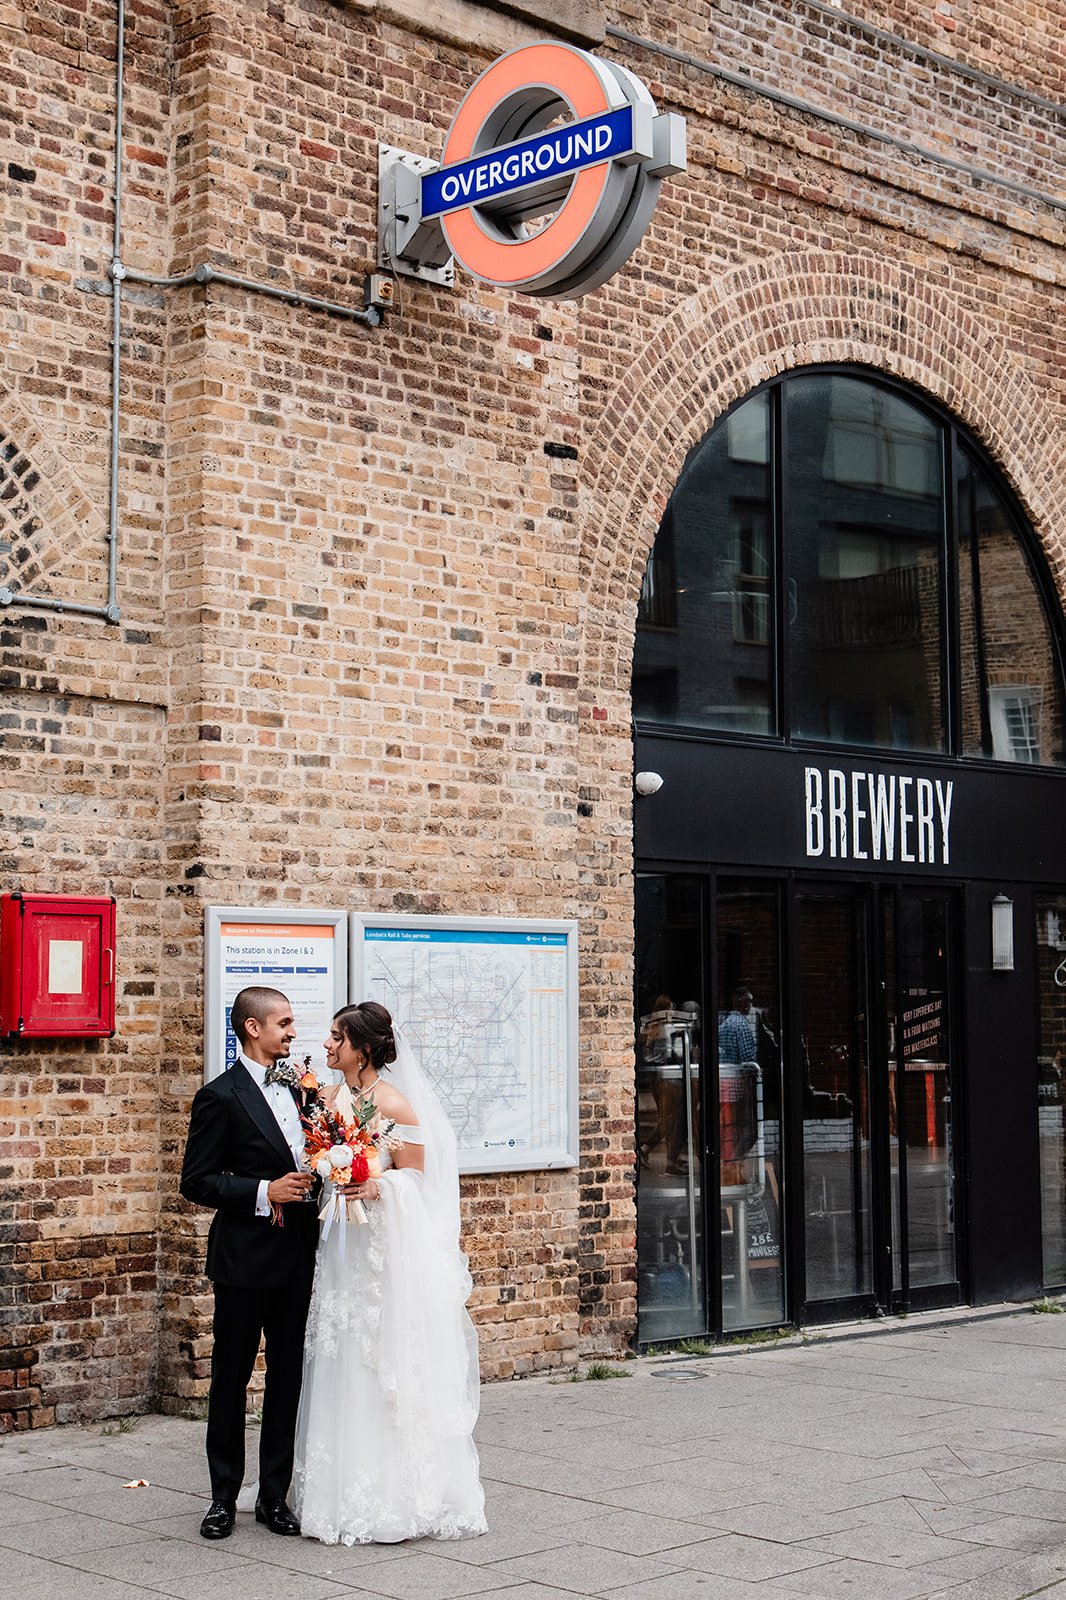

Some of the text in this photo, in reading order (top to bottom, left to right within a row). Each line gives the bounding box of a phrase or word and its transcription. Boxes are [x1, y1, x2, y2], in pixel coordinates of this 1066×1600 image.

[441, 125, 612, 201] OVERGROUND
[804, 767, 953, 865] BREWERY
[226, 946, 240, 954] This
[241, 946, 266, 954] station
[266, 947, 272, 955] is
[273, 947, 280, 955] in
[281, 947, 298, 955] Zone
[303, 947, 309, 955] &
[310, 947, 314, 955] 2
